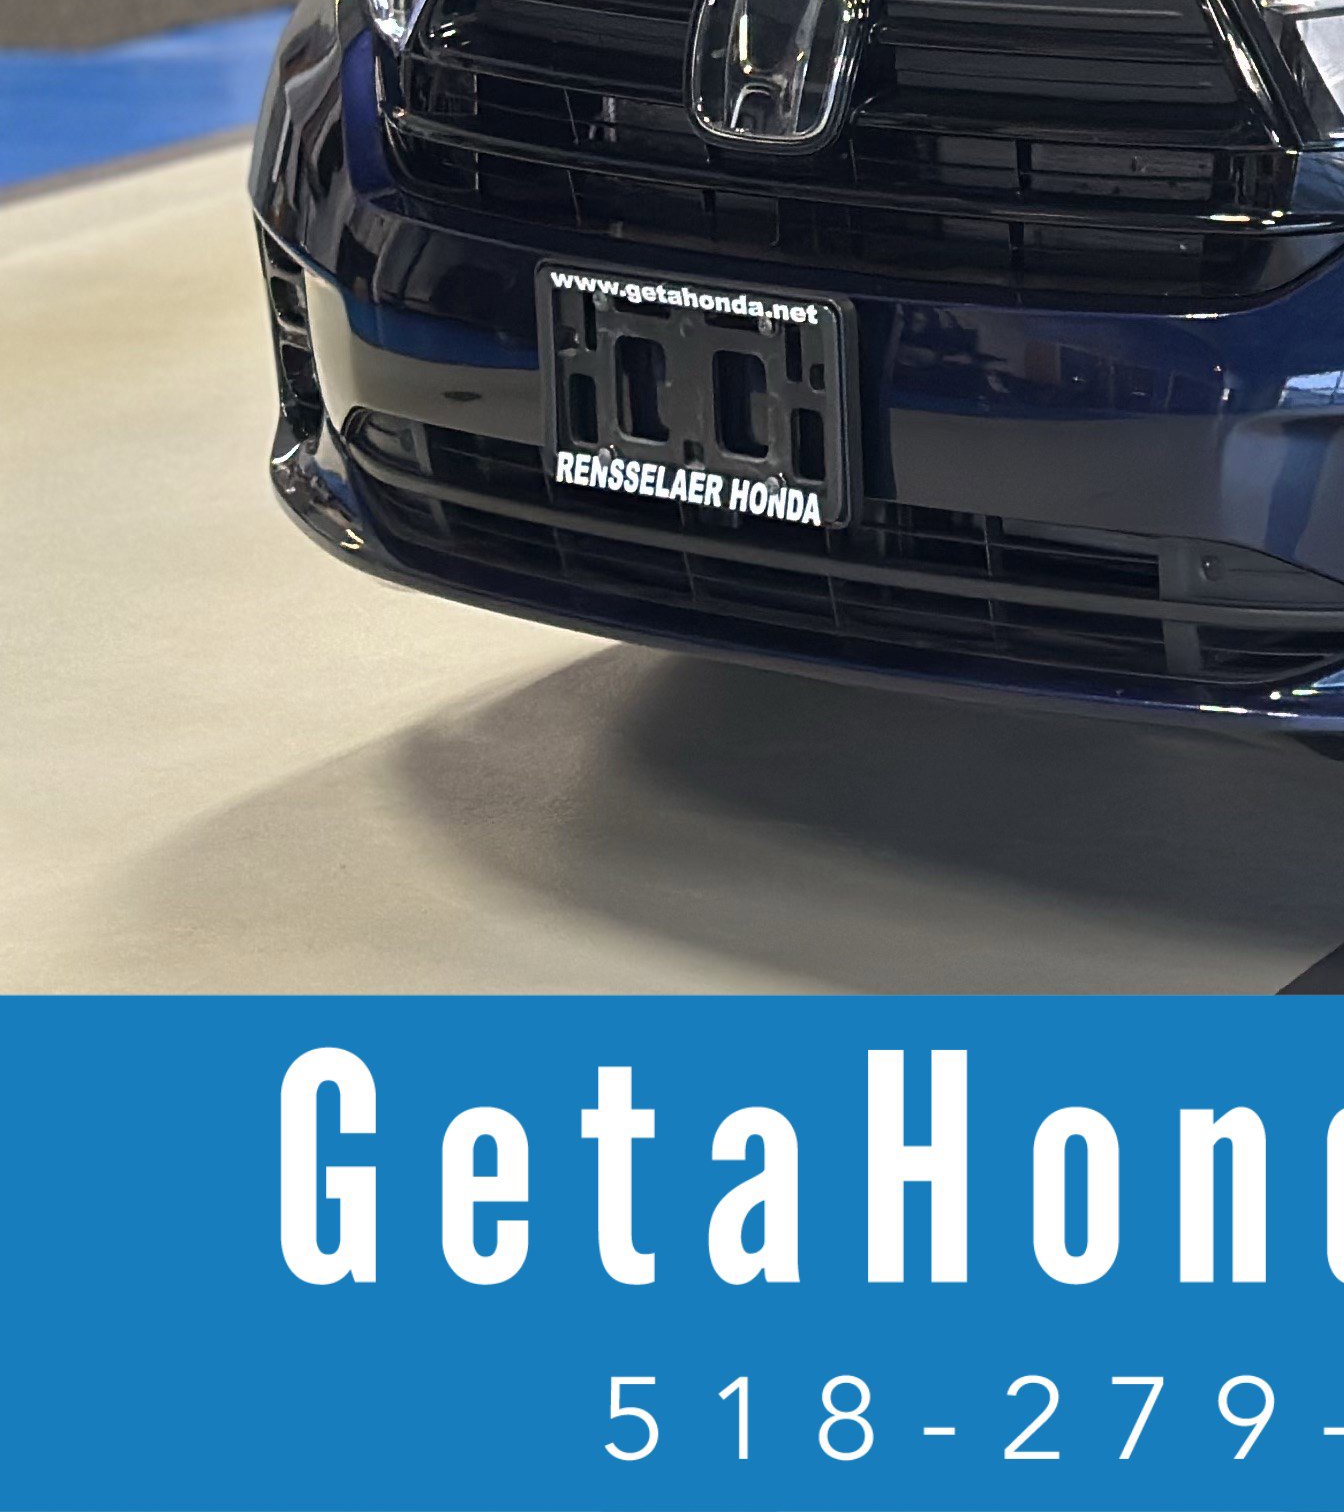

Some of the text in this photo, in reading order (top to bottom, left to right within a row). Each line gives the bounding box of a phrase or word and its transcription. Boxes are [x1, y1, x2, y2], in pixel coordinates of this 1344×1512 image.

[550, 271, 818, 325] www.getahonda.net
[556, 450, 822, 527] RENSSELAER HONDA
